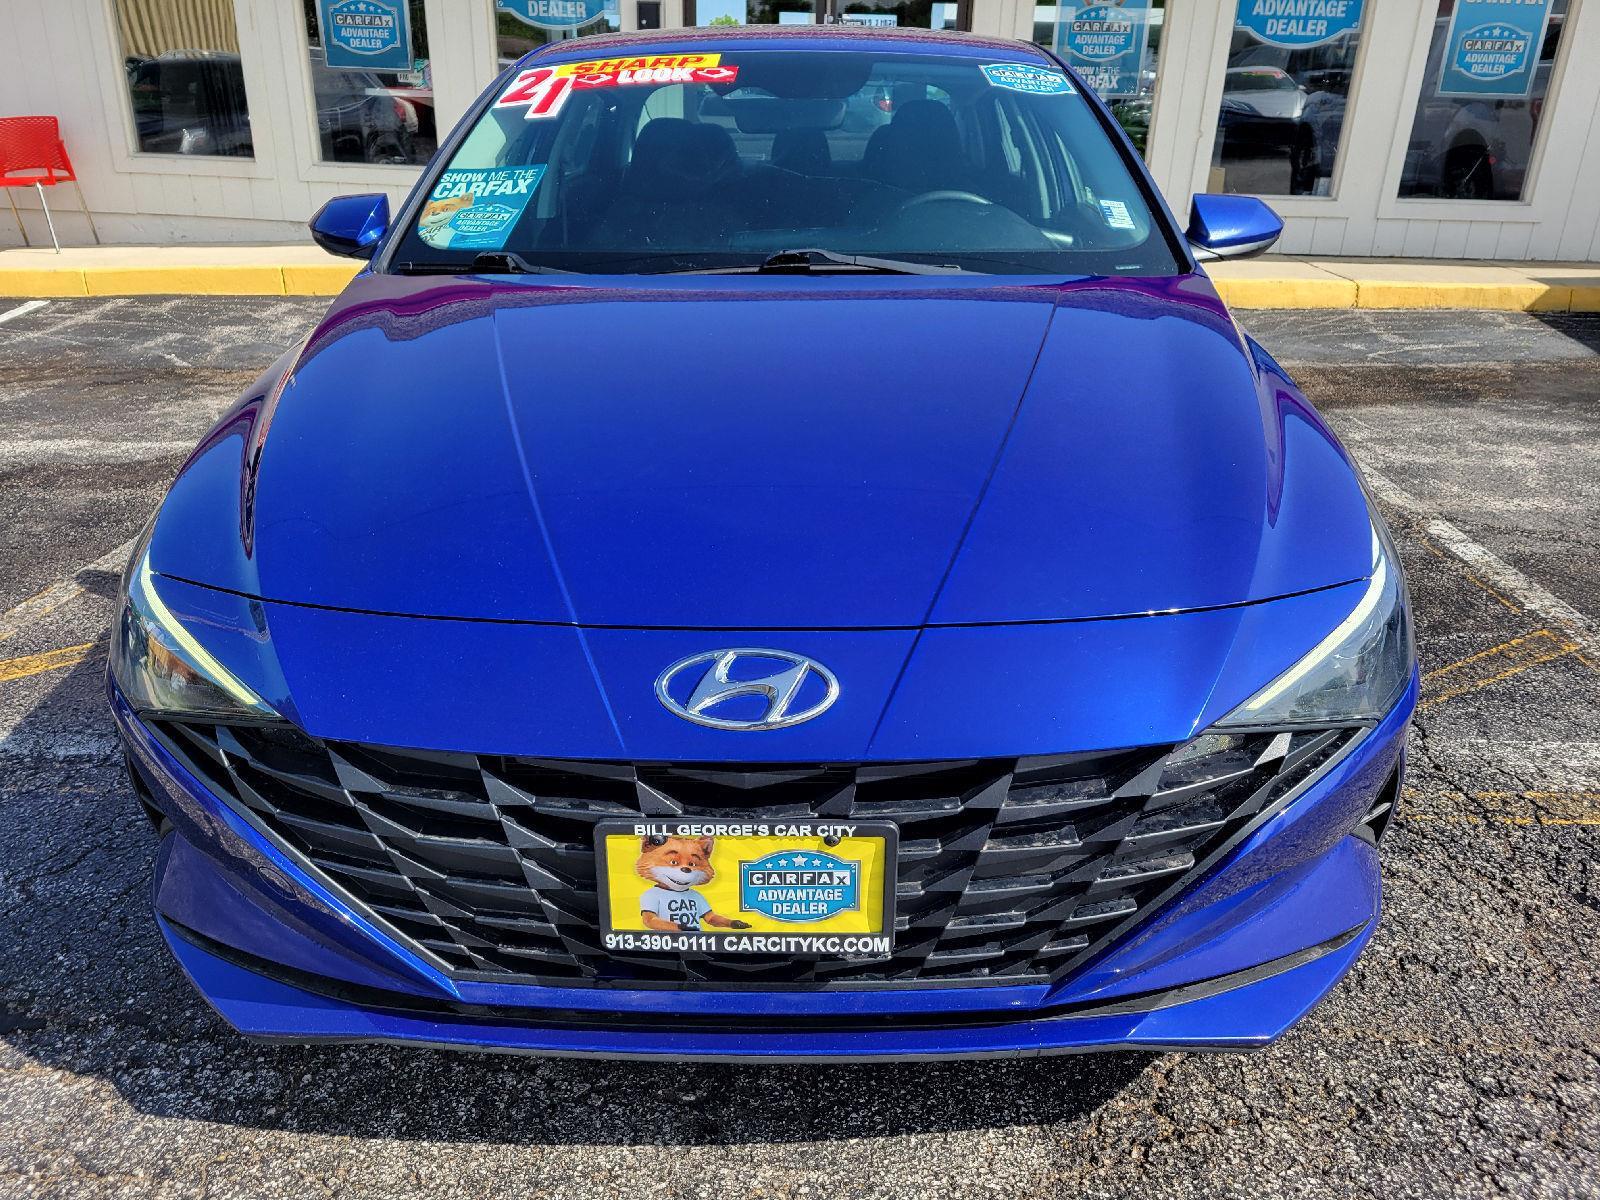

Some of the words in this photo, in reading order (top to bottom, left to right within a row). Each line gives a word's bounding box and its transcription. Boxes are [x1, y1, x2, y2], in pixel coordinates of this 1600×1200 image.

[528, 0, 587, 18] DEALER
[1252, 0, 1347, 17] ADVANTAGE
[336, 15, 391, 27] CARFAX
[1073, 22, 1130, 32] CARFAX
[341, 28, 390, 38] ADVANTAGE
[1266, 19, 1328, 36] DEALER
[350, 38, 382, 48] DEALER
[1075, 34, 1125, 45] ADVANTAGE
[1083, 45, 1116, 55] DEALER
[1464, 40, 1524, 52] CARFAX
[1464, 53, 1517, 64] ADVANTAGE
[571, 56, 705, 74] SHARP
[1107, 66, 1120, 75] THE
[1471, 64, 1506, 74] DEALER
[616, 67, 696, 83] LOOK
[1001, 77, 1060, 87] ADVANTAGE
[497, 67, 572, 116] 21
[440, 172, 489, 183] SHOW
[488, 170, 511, 181] ME
[513, 168, 540, 180] THE
[433, 178, 534, 199] CARFAX
[634, 824, 673, 836] BILL
[676, 824, 769, 836] GEORGE'S
[774, 825, 812, 837] CAR
[817, 825, 857, 838] CITY
[751, 872, 849, 886] CARFAX
[757, 889, 843, 901] ADVANTAGE
[667, 899, 698, 912] CAR
[772, 902, 828, 915] DEALER
[669, 913, 700, 925] FOX
[605, 934, 716, 951] 913-390-0111
[723, 936, 890, 952] CARCITYKC.COM
